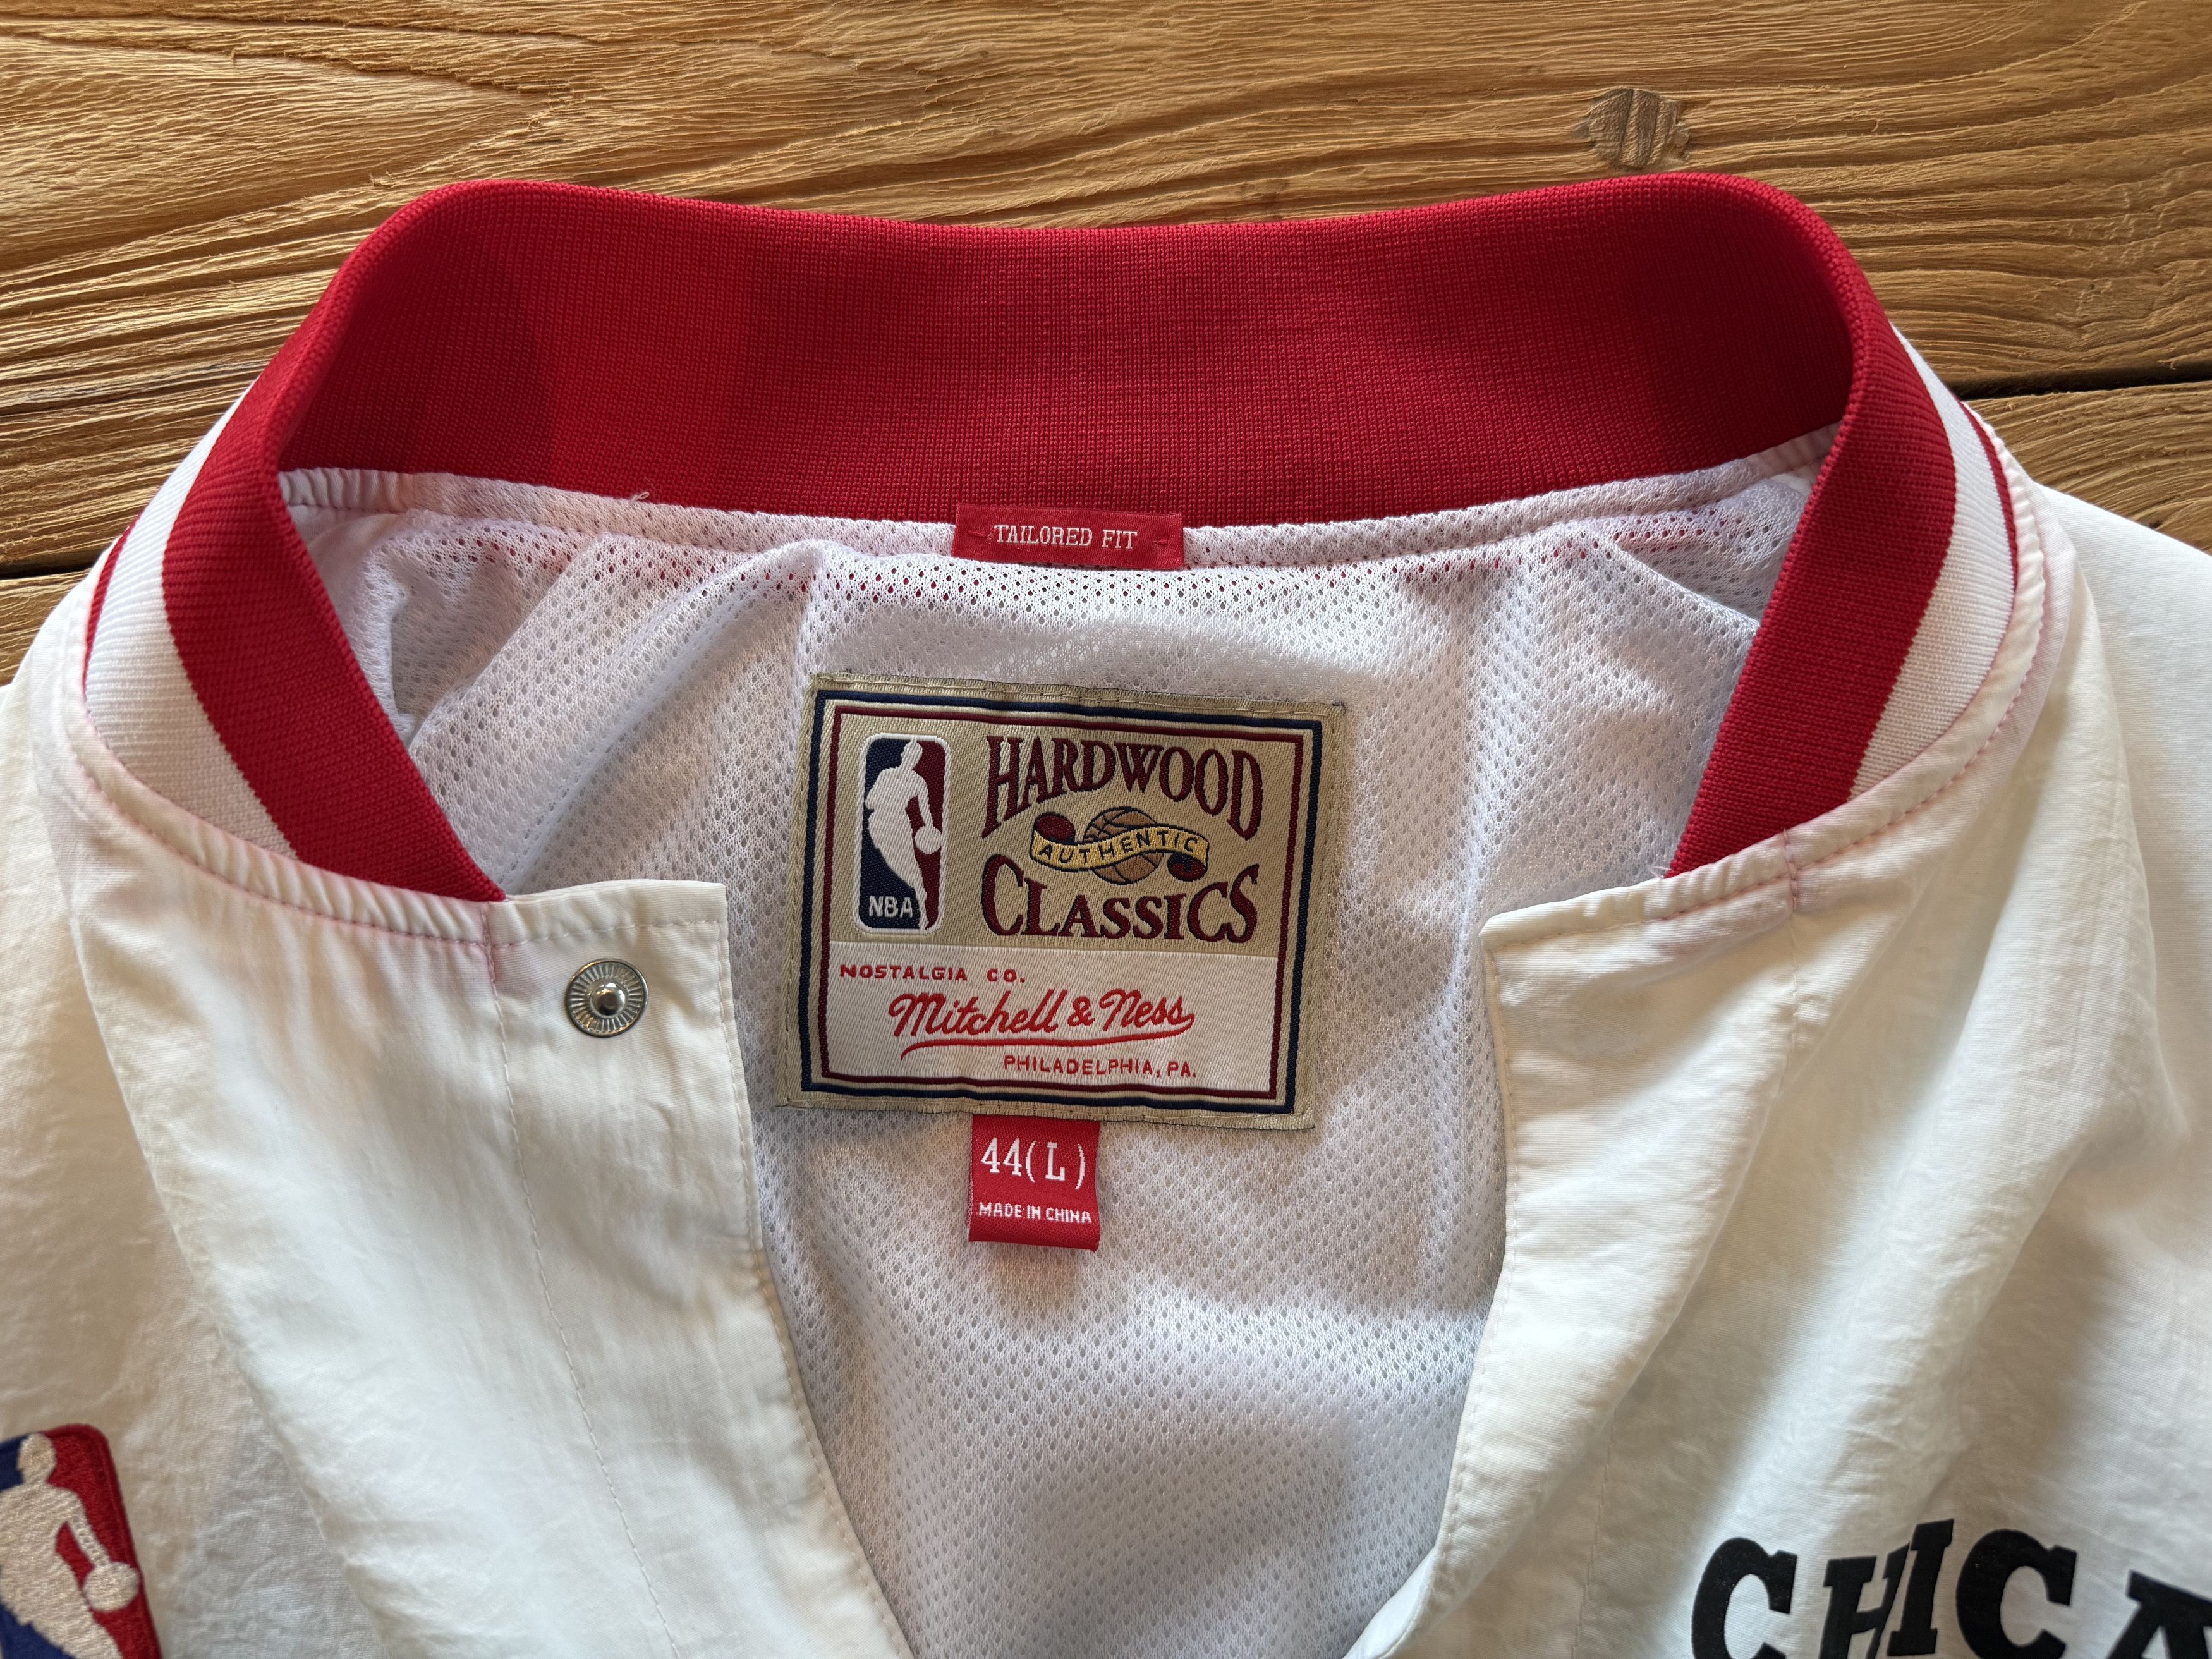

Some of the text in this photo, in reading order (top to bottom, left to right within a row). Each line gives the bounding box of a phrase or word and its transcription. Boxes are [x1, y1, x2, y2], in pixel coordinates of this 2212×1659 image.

[994, 525, 1138, 549] TAILORED FIT
[981, 736, 1263, 841] HARDWOOD
[1038, 830, 1198, 863] AUTHENTIC
[869, 896, 913, 918] NBA
[981, 853, 1260, 943] CLASSICS
[839, 963, 1026, 983] NOSTALGIA CO.
[889, 988, 1194, 1038] Mitchell & Ness
[1004, 1055, 1197, 1078] PHILADELPHIA, PA.
[979, 1201, 1093, 1223] MADE IN CHINA
